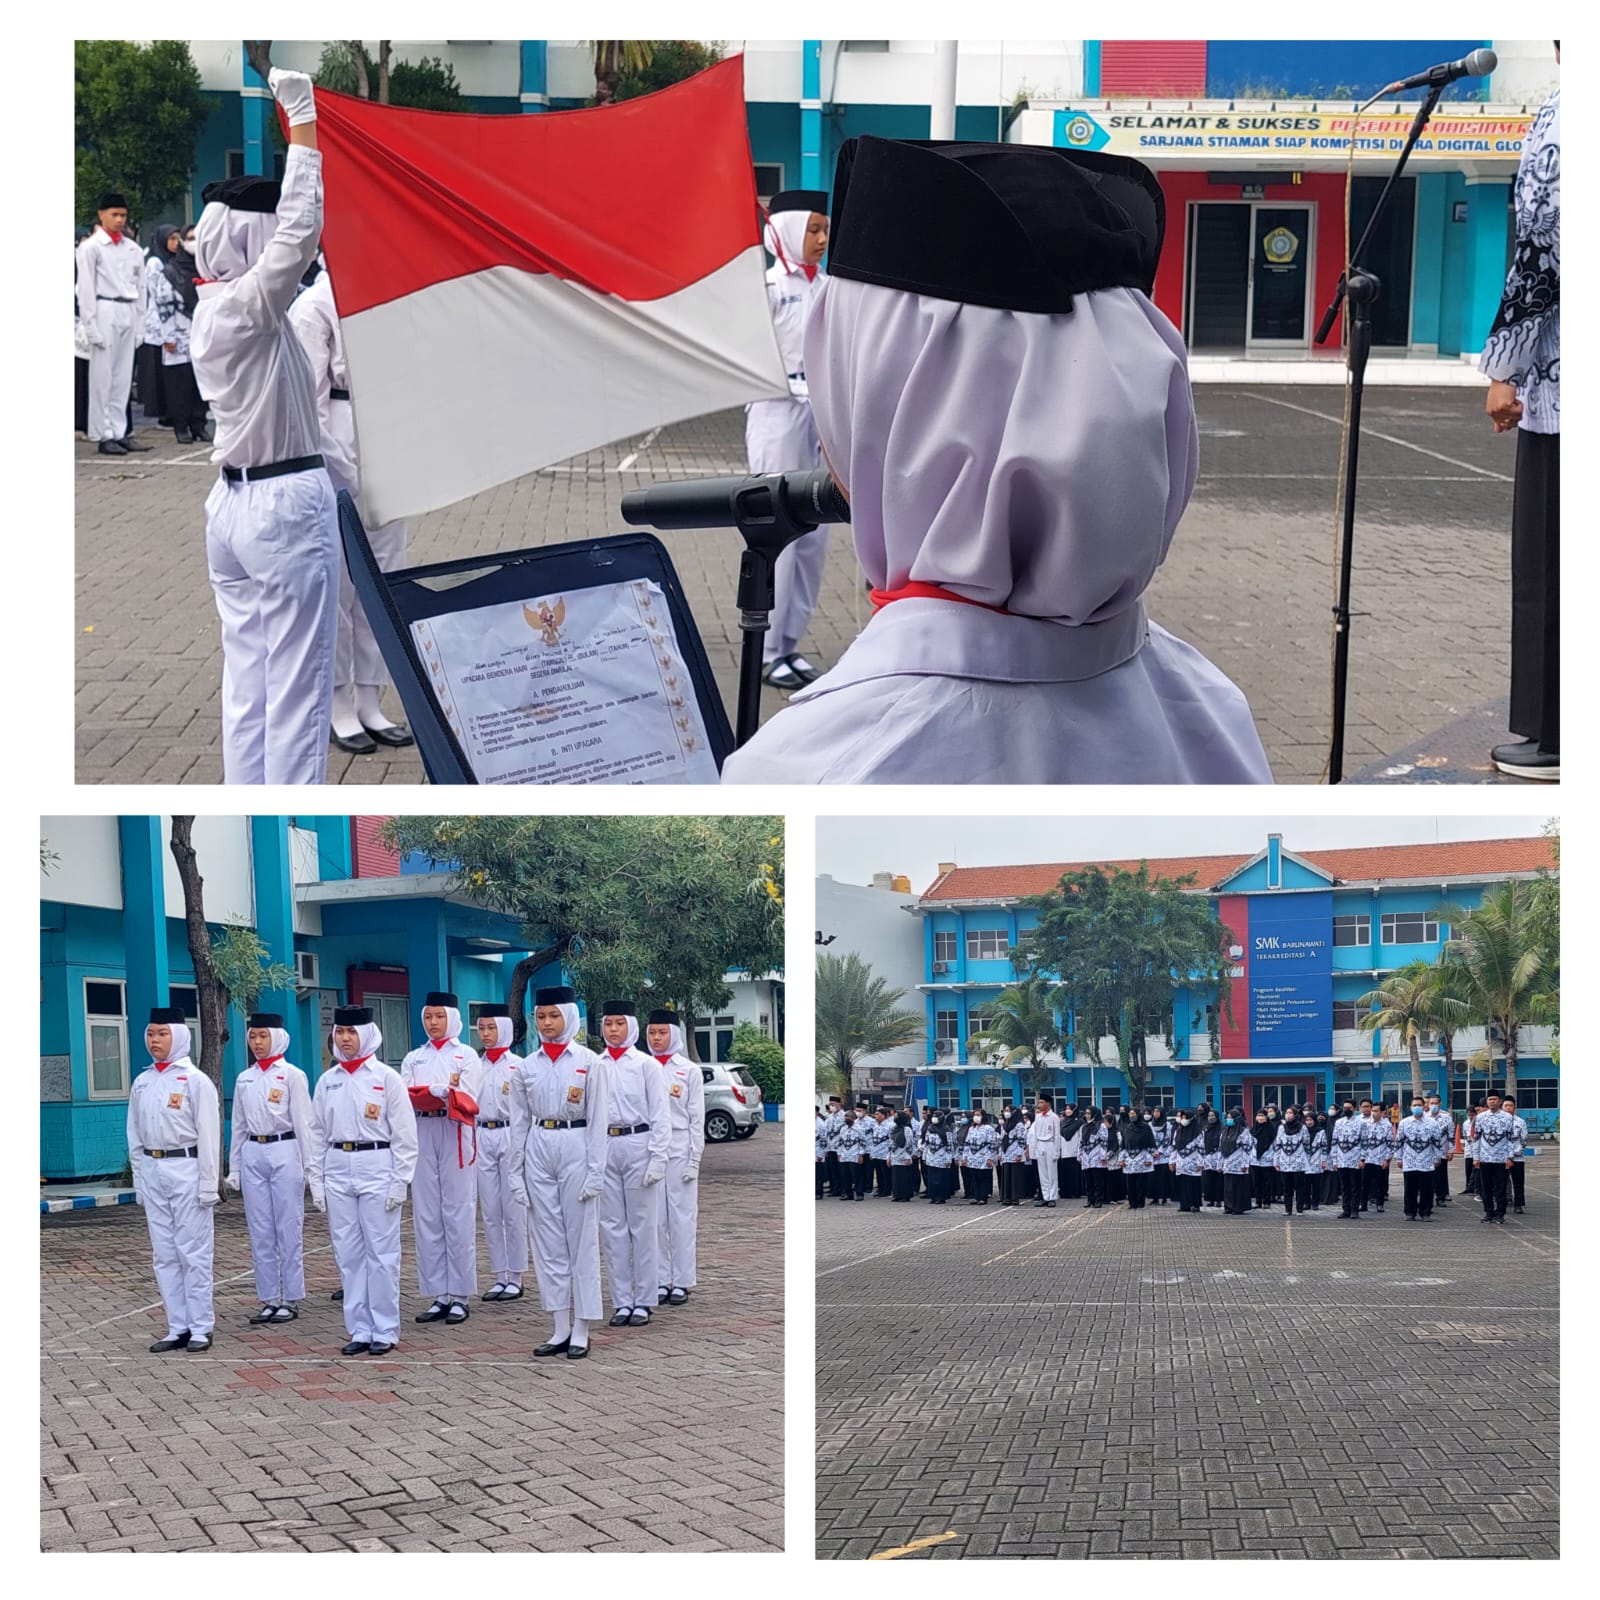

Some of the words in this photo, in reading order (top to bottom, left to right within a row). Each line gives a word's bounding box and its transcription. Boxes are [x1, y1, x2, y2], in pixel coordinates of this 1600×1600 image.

[1109, 116, 1210, 129] SELAMAT
[1216, 117, 1230, 129] &
[1237, 118, 1320, 130] SUKSES
[1139, 135, 1203, 146] SARJANA
[1208, 136, 1270, 147] STIAMAK
[1274, 137, 1306, 147] SIAP
[1310, 137, 1385, 149] KOMPETISI
[1389, 139, 1403, 149] DI
[1413, 139, 1433, 150] RA
[1438, 140, 1490, 151] DIGITAL
[461, 673, 486, 684] UPACARA
[486, 667, 513, 680] BENDERA
[541, 681, 585, 696] PENDAHULUAN
[574, 736, 603, 750] UPACARA
[1255, 937, 1280, 950] SMK
[1282, 940, 1325, 949] BARUNAWATI
[1256, 952, 1305, 960] TERAKREDITASI
